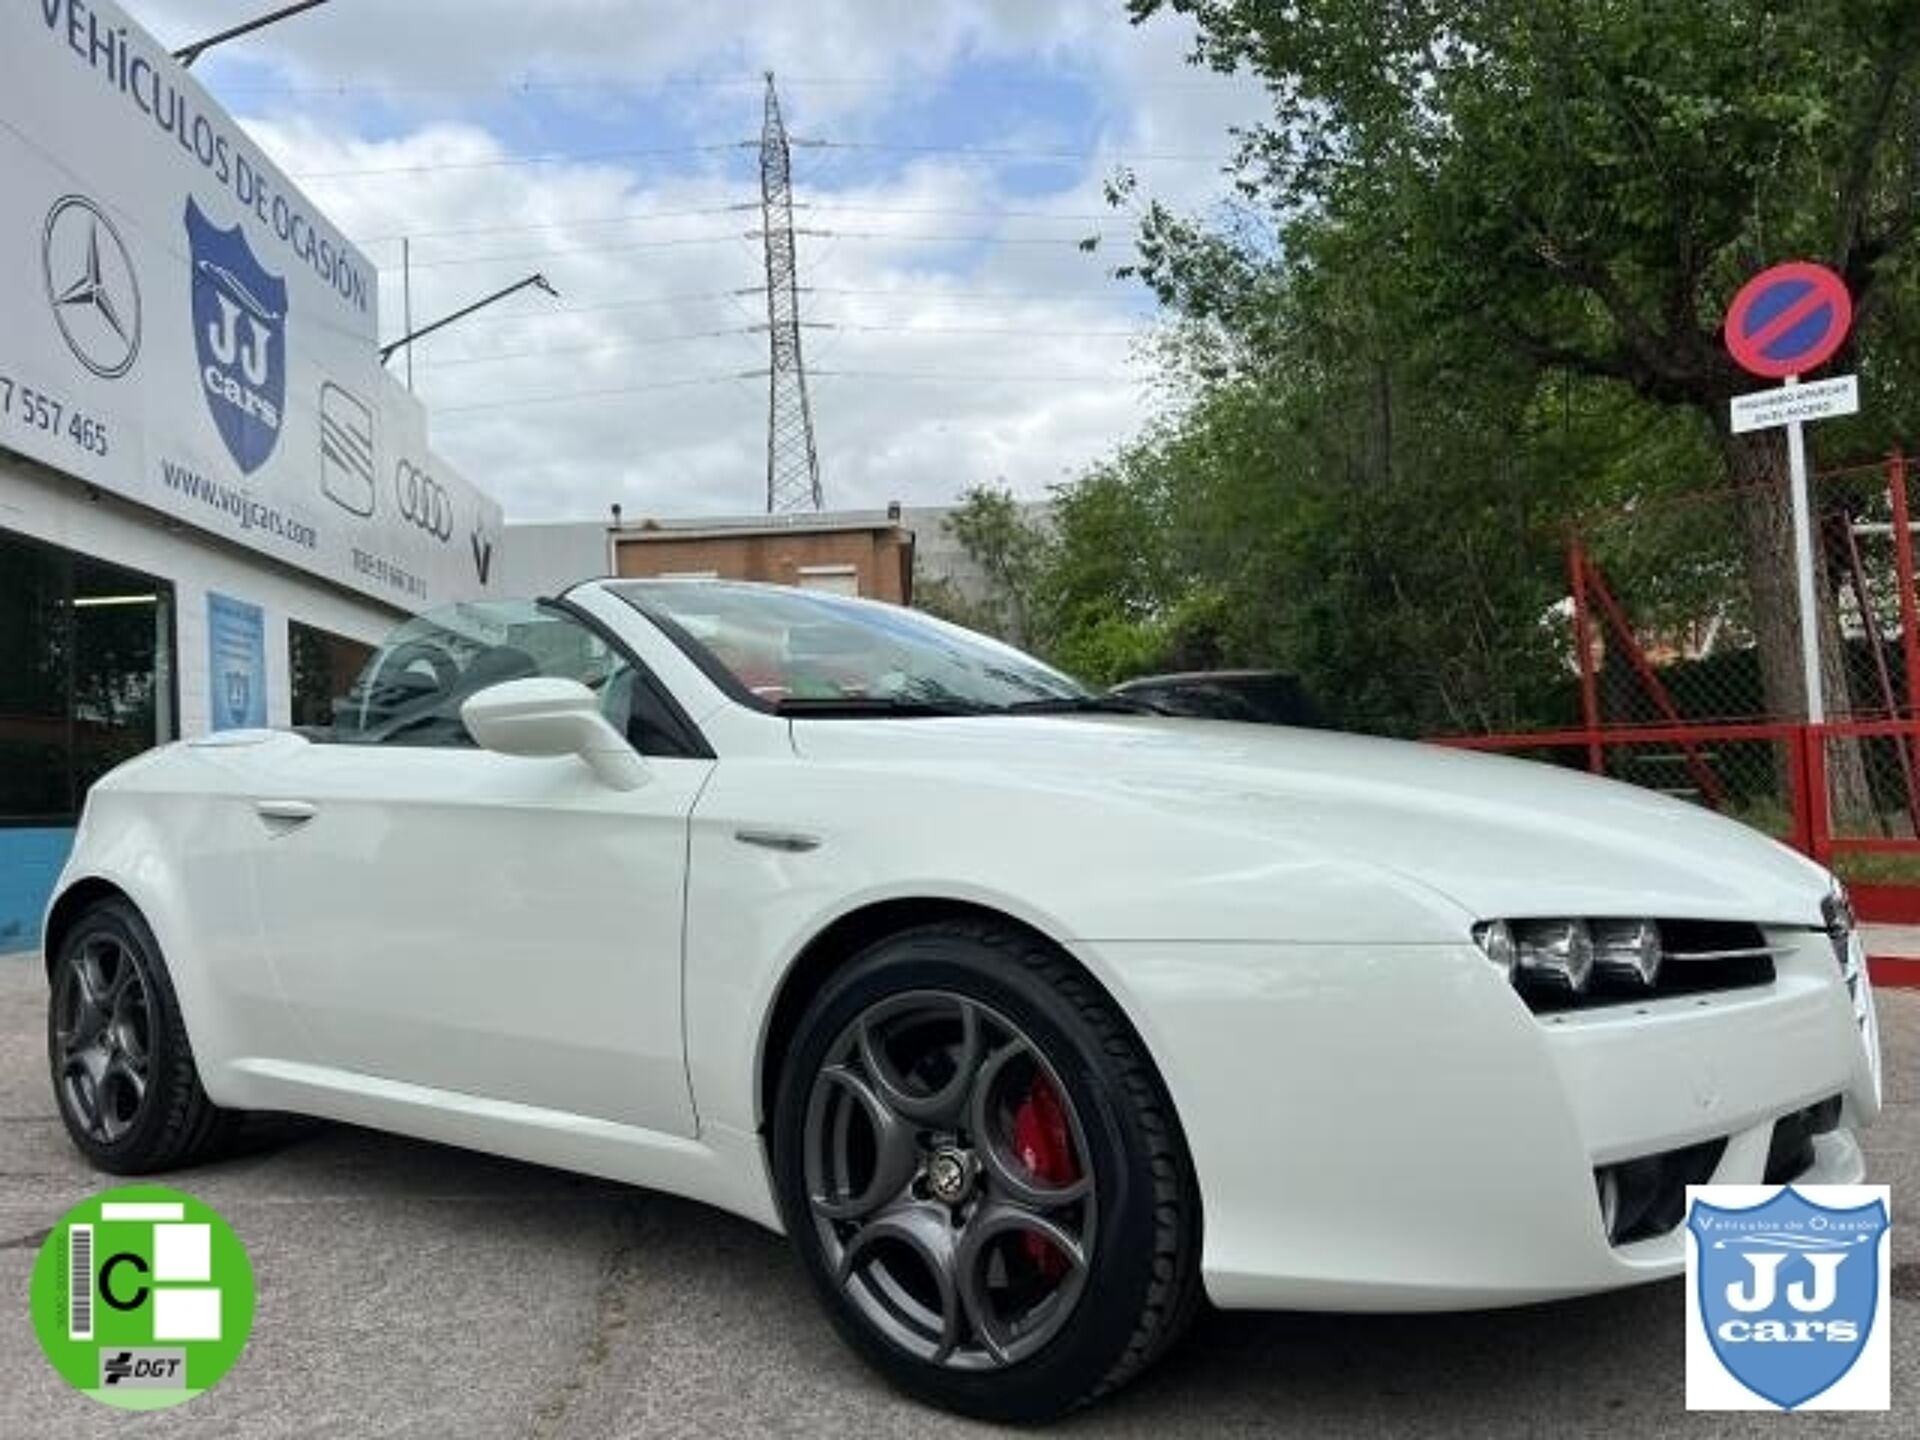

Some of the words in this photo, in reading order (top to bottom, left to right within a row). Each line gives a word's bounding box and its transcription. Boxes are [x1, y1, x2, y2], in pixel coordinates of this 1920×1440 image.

[41, 0, 230, 185] VEHÍCULOS
[236, 154, 267, 225] DE
[272, 195, 367, 312] OCASIÓN
[208, 289, 271, 385] JJ
[22, 387, 63, 436] 557
[69, 412, 107, 457] 465
[204, 365, 278, 429] cars
